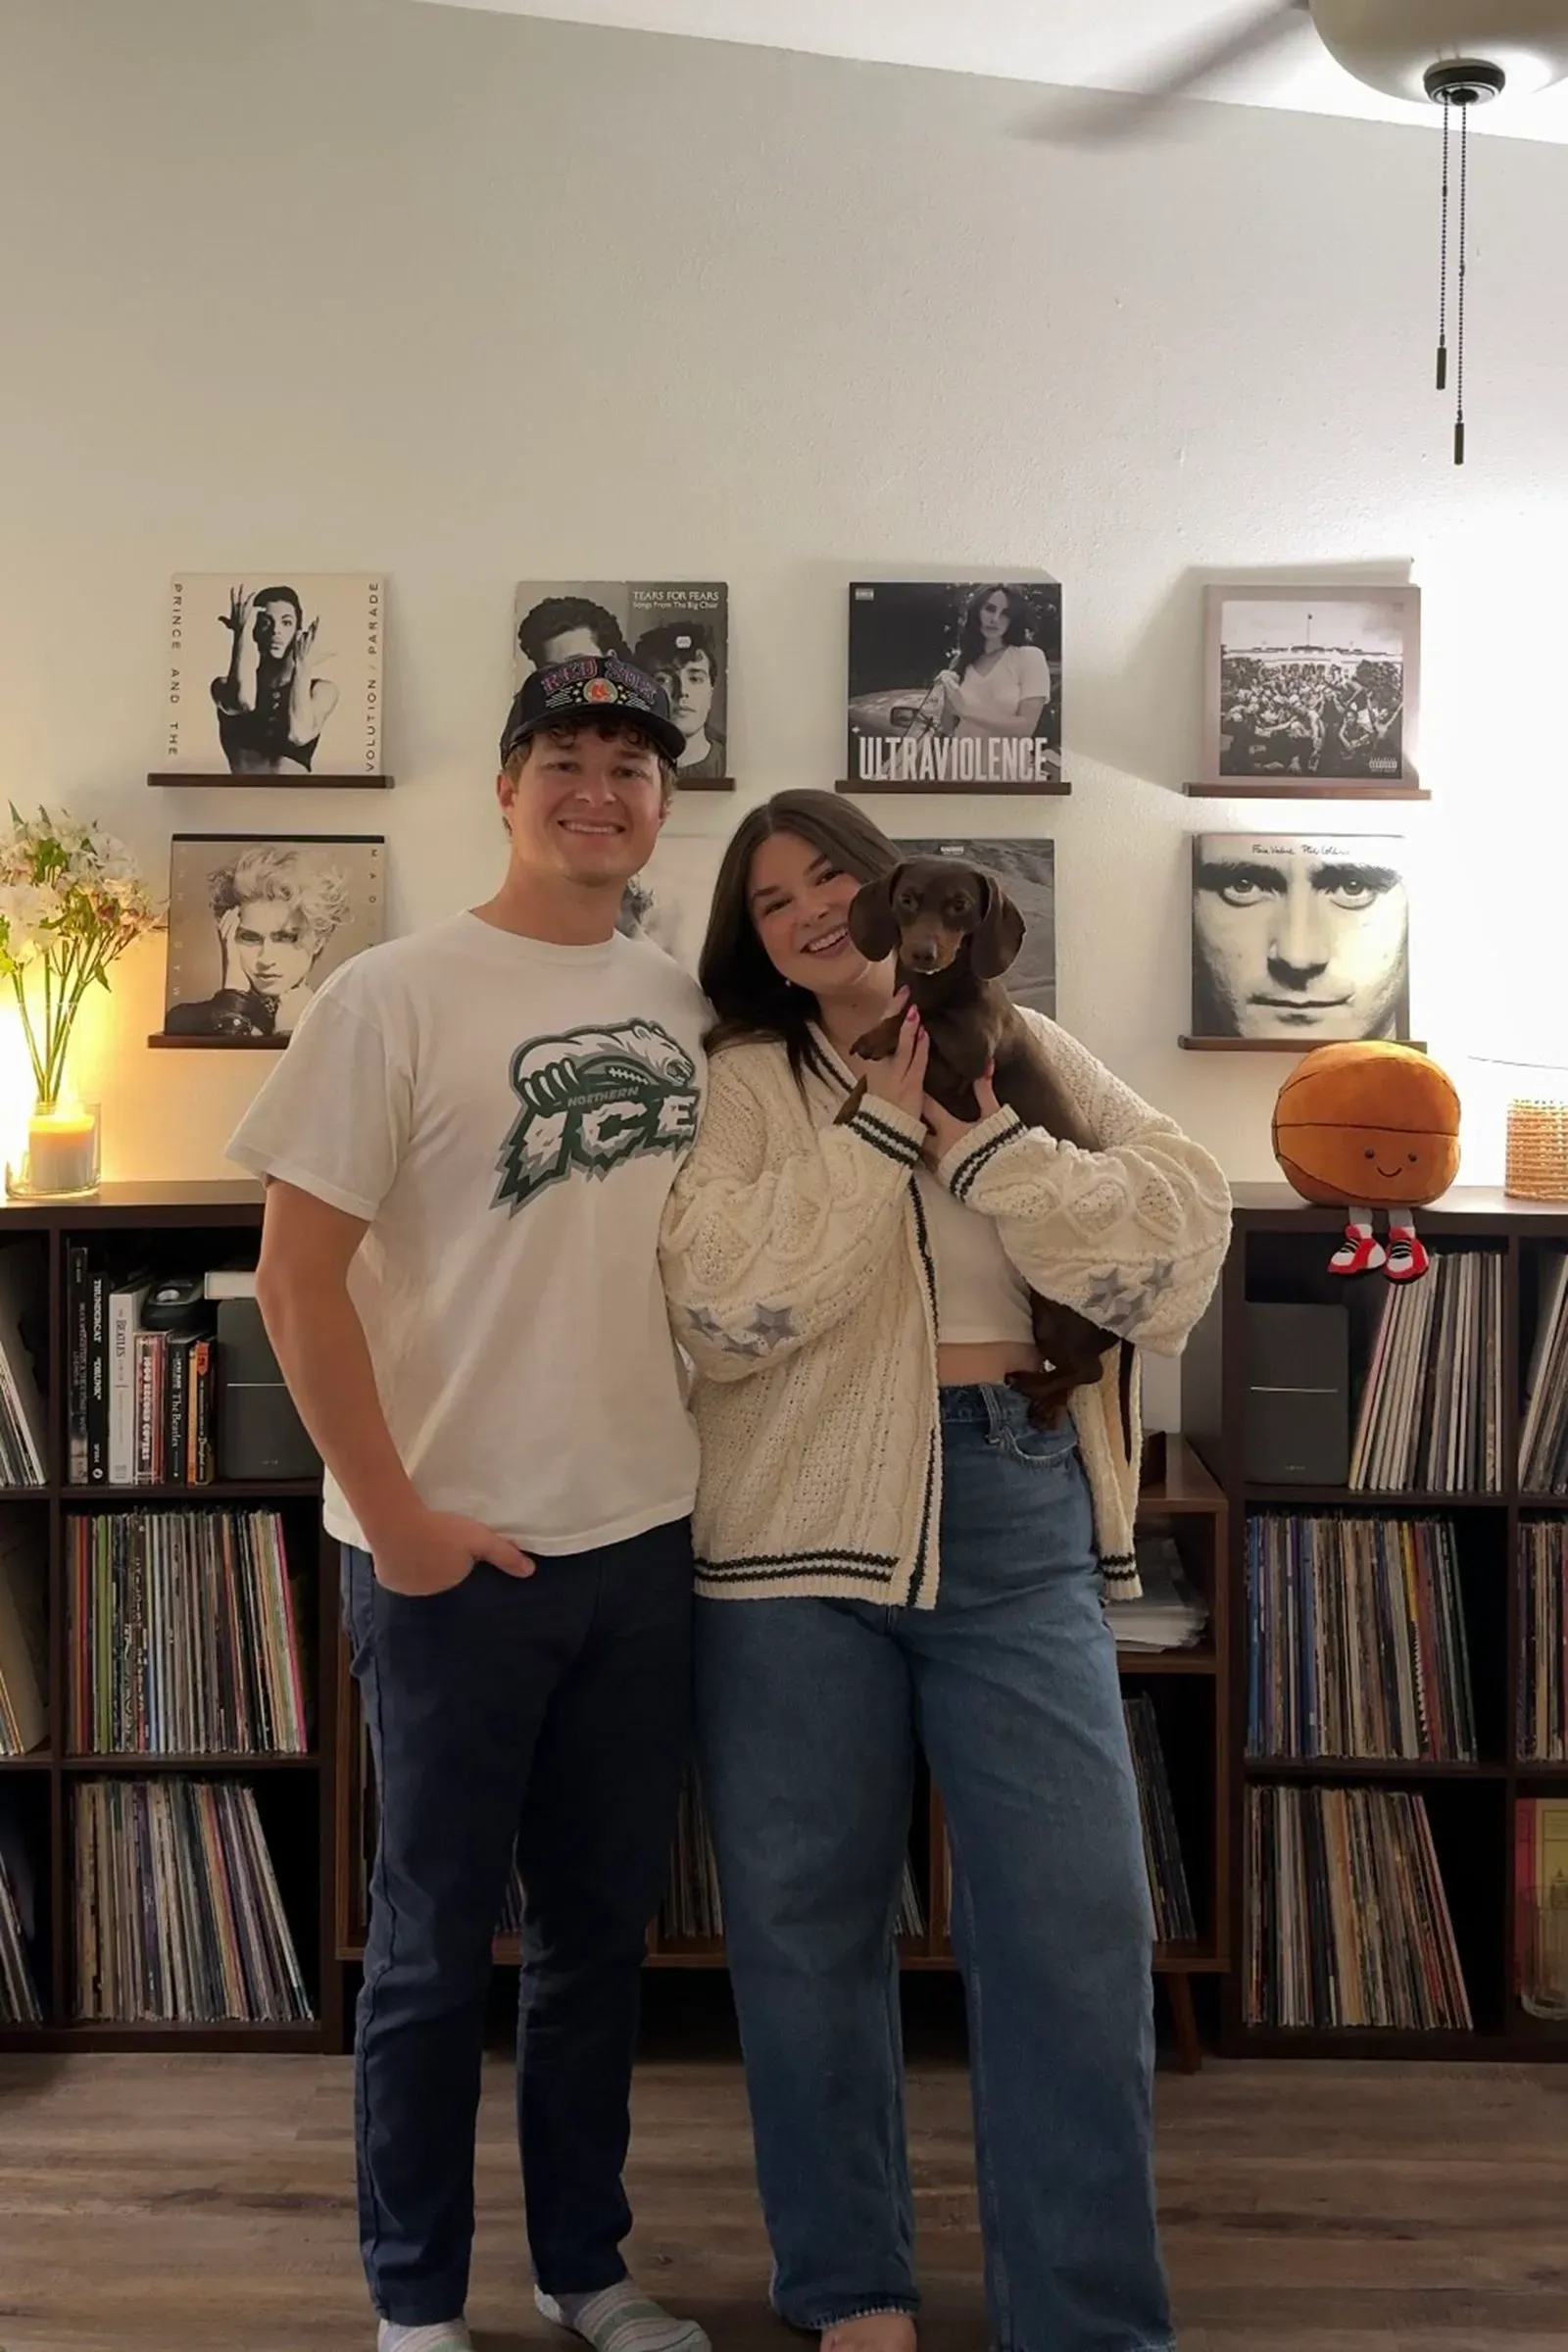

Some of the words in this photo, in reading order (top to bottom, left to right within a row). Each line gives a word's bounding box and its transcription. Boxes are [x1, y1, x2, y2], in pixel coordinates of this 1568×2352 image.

[633, 591, 663, 601] TEARS
[666, 592, 686, 601] FOR
[689, 592, 719, 601] FEARS
[171, 583, 183, 650] PRINCE
[368, 583, 378, 655] PARADE
[170, 668, 180, 704] AND
[168, 722, 178, 756] THE
[365, 679, 376, 772] VOLUTION
[858, 737, 1048, 781] ULTRAVIOLENCE
[567, 1086, 640, 1107] NORTHERN
[514, 1093, 698, 1186] ICE
[93, 1278, 102, 1343] THUNDERCAT
[172, 1393, 182, 1412] The
[171, 1414, 182, 1447] Beatles
